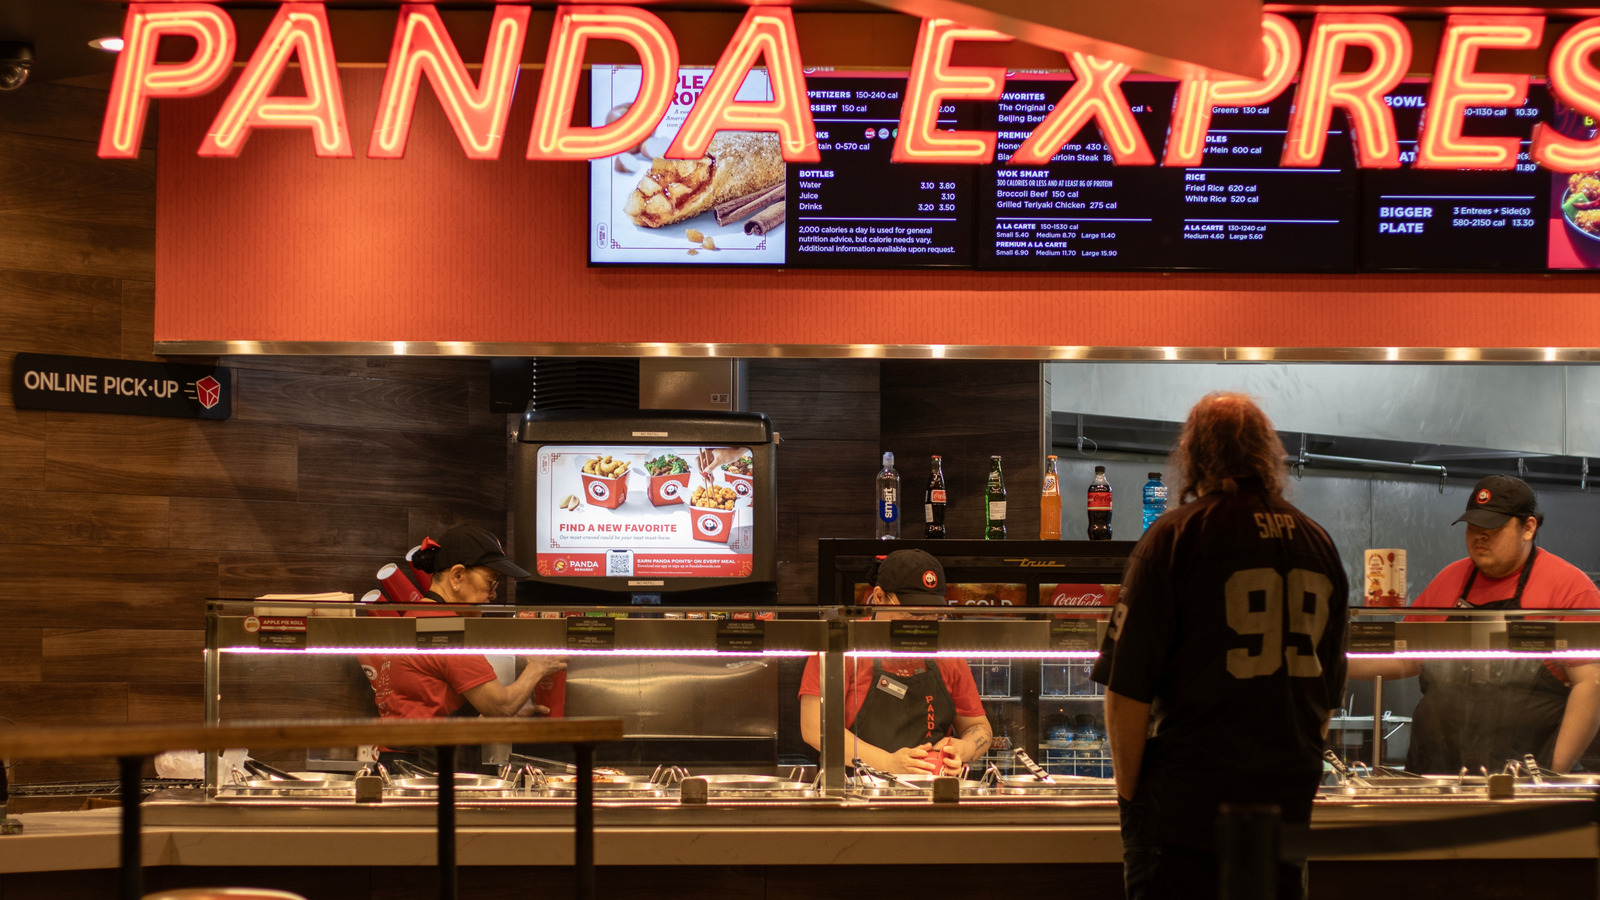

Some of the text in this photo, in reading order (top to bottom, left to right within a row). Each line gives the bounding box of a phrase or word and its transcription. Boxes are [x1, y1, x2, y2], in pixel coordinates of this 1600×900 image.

[97, 3, 1600, 172] PANDA EXPRES
[1014, 104, 1046, 112] Original
[1258, 106, 1270, 114] cal
[1516, 108, 1538, 116] 10.30
[998, 114, 1026, 124] Beijing
[834, 142, 870, 150] 0-570 cal
[1076, 154, 1098, 162] Steak
[1516, 164, 1536, 172] 11.80
[996, 170, 1018, 178] WOK
[920, 182, 934, 190] 3.10
[1244, 184, 1256, 192] cal
[942, 192, 956, 200] 3.10
[996, 190, 1028, 198] Broccoli
[1184, 194, 1208, 202] White
[996, 200, 1022, 208] Grilled
[1024, 200, 1052, 210] Teriyaki
[1380, 206, 1432, 218] BIGGER
[1454, 206, 1460, 214] 3
[1460, 206, 1492, 214] Entrees
[1500, 208, 1530, 216] Side(s)
[1452, 218, 1534, 226] 580-2150 cal 13.30
[798, 226, 820, 234] 2,000
[854, 226, 868, 234] day
[1380, 222, 1424, 232] PLATE
[830, 236, 854, 244] advice,
[836, 244, 876, 252] information
[24, 370, 98, 394] ONLINE
[884, 488, 892, 518] smart
[560, 524, 677, 532] FIND A NEW FAVORITE
[1254, 512, 1296, 540] SAPP
[1225, 568, 1334, 679] 99
[925, 696, 934, 738] PANDA
